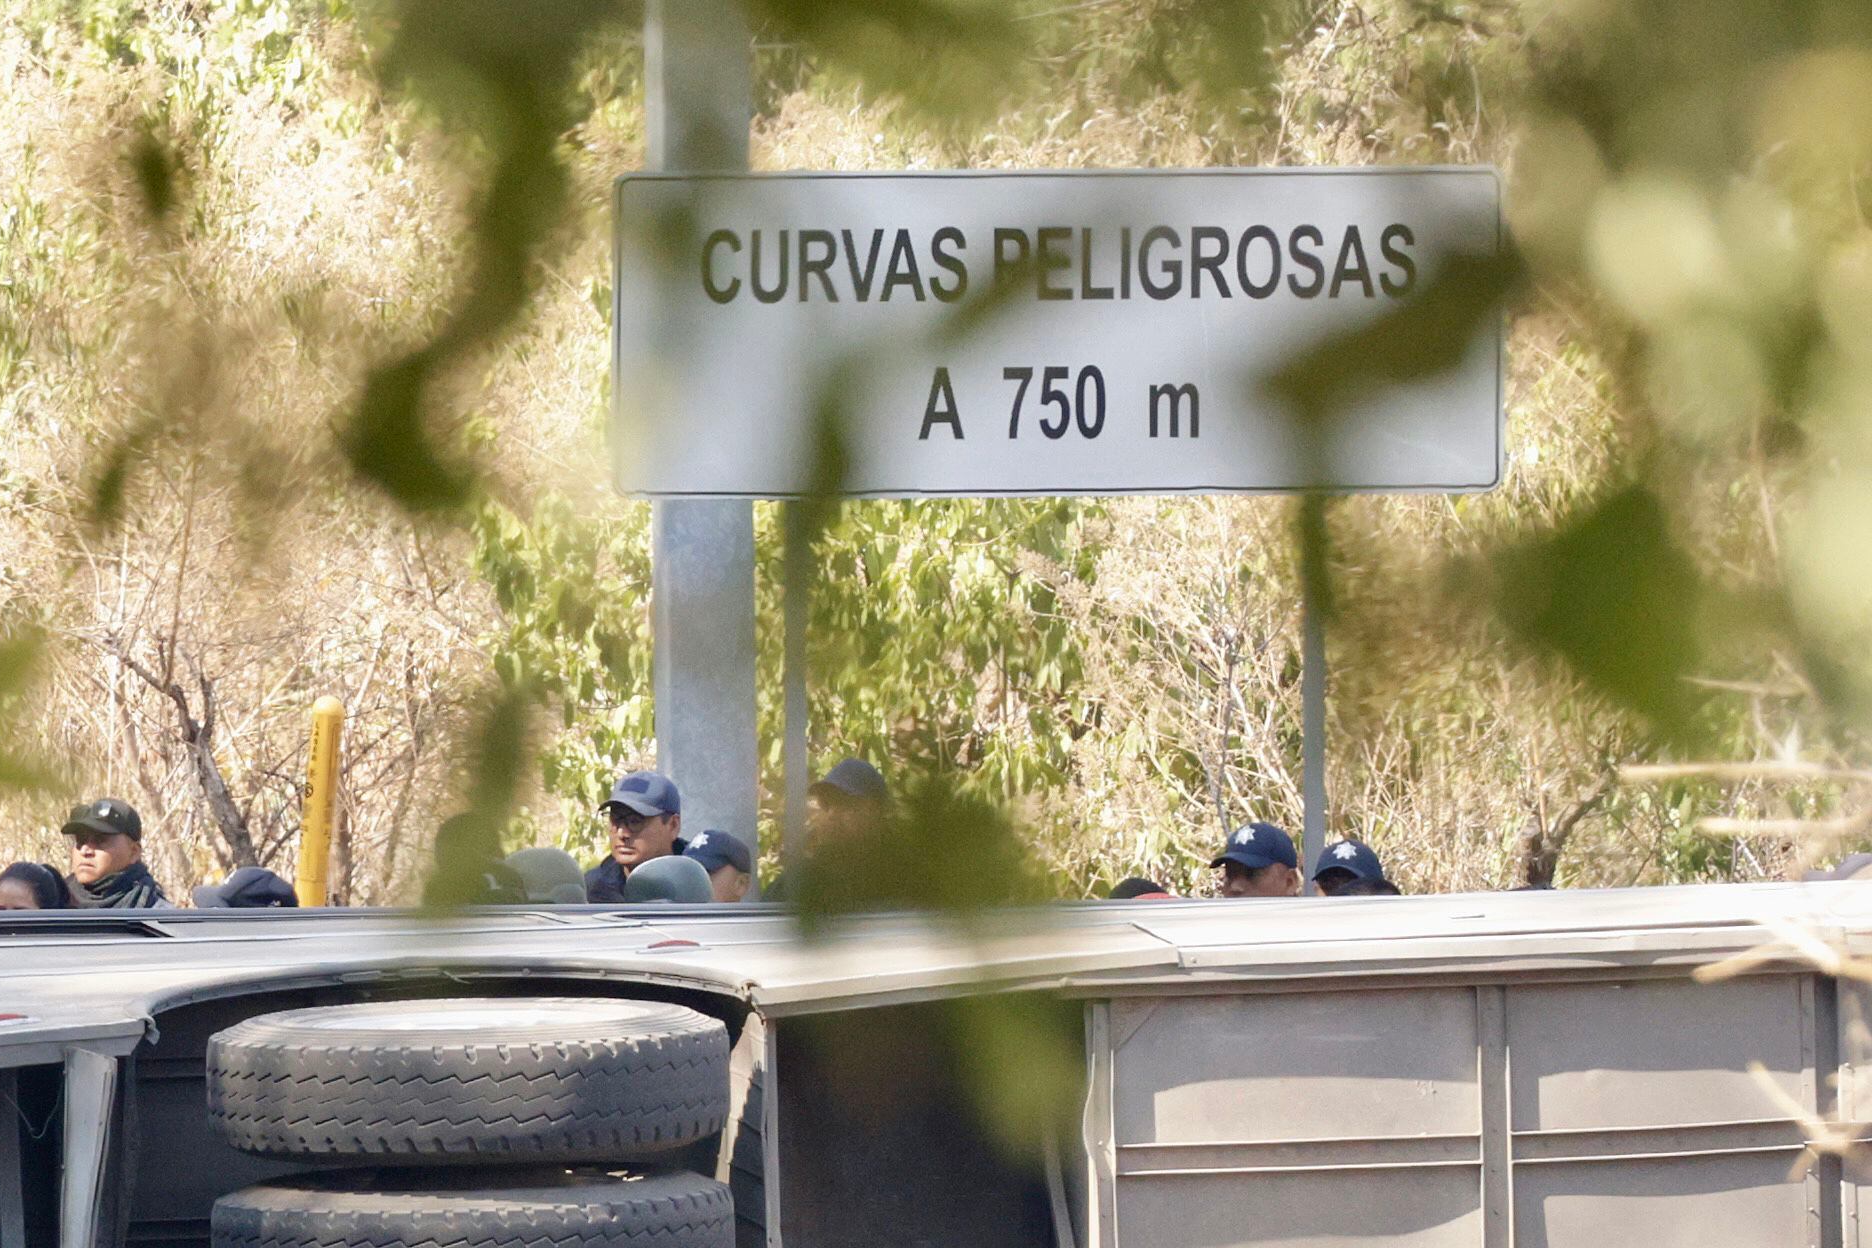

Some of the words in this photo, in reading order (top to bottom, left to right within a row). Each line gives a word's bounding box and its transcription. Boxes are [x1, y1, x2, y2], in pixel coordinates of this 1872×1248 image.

[699, 226, 969, 305] CURVAS
[994, 222, 1417, 302] PELIGROSAS
[918, 366, 966, 441] A
[1003, 364, 1107, 441] 750
[1148, 379, 1201, 440] m
